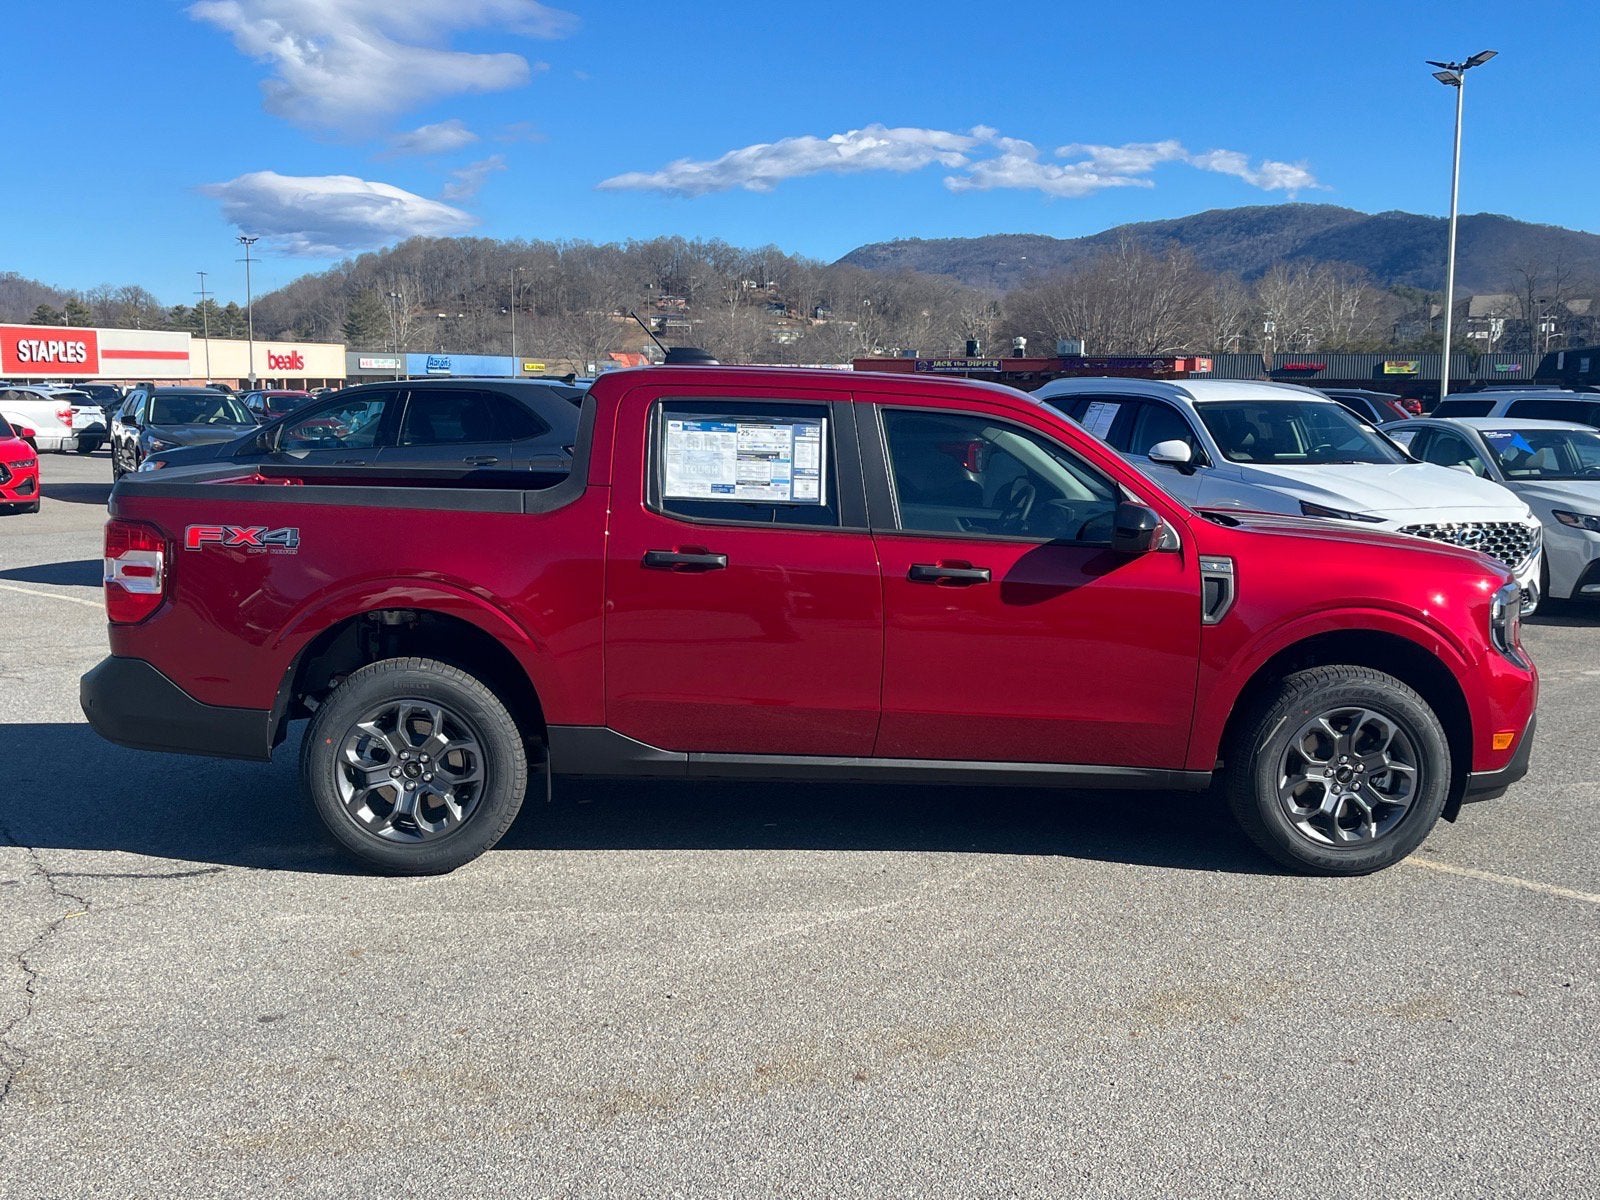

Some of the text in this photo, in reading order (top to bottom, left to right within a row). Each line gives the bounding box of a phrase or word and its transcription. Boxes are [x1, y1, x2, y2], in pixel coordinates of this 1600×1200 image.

[17, 339, 87, 363] STAPLES
[267, 349, 305, 370] bealls
[185, 524, 300, 551] FX4
